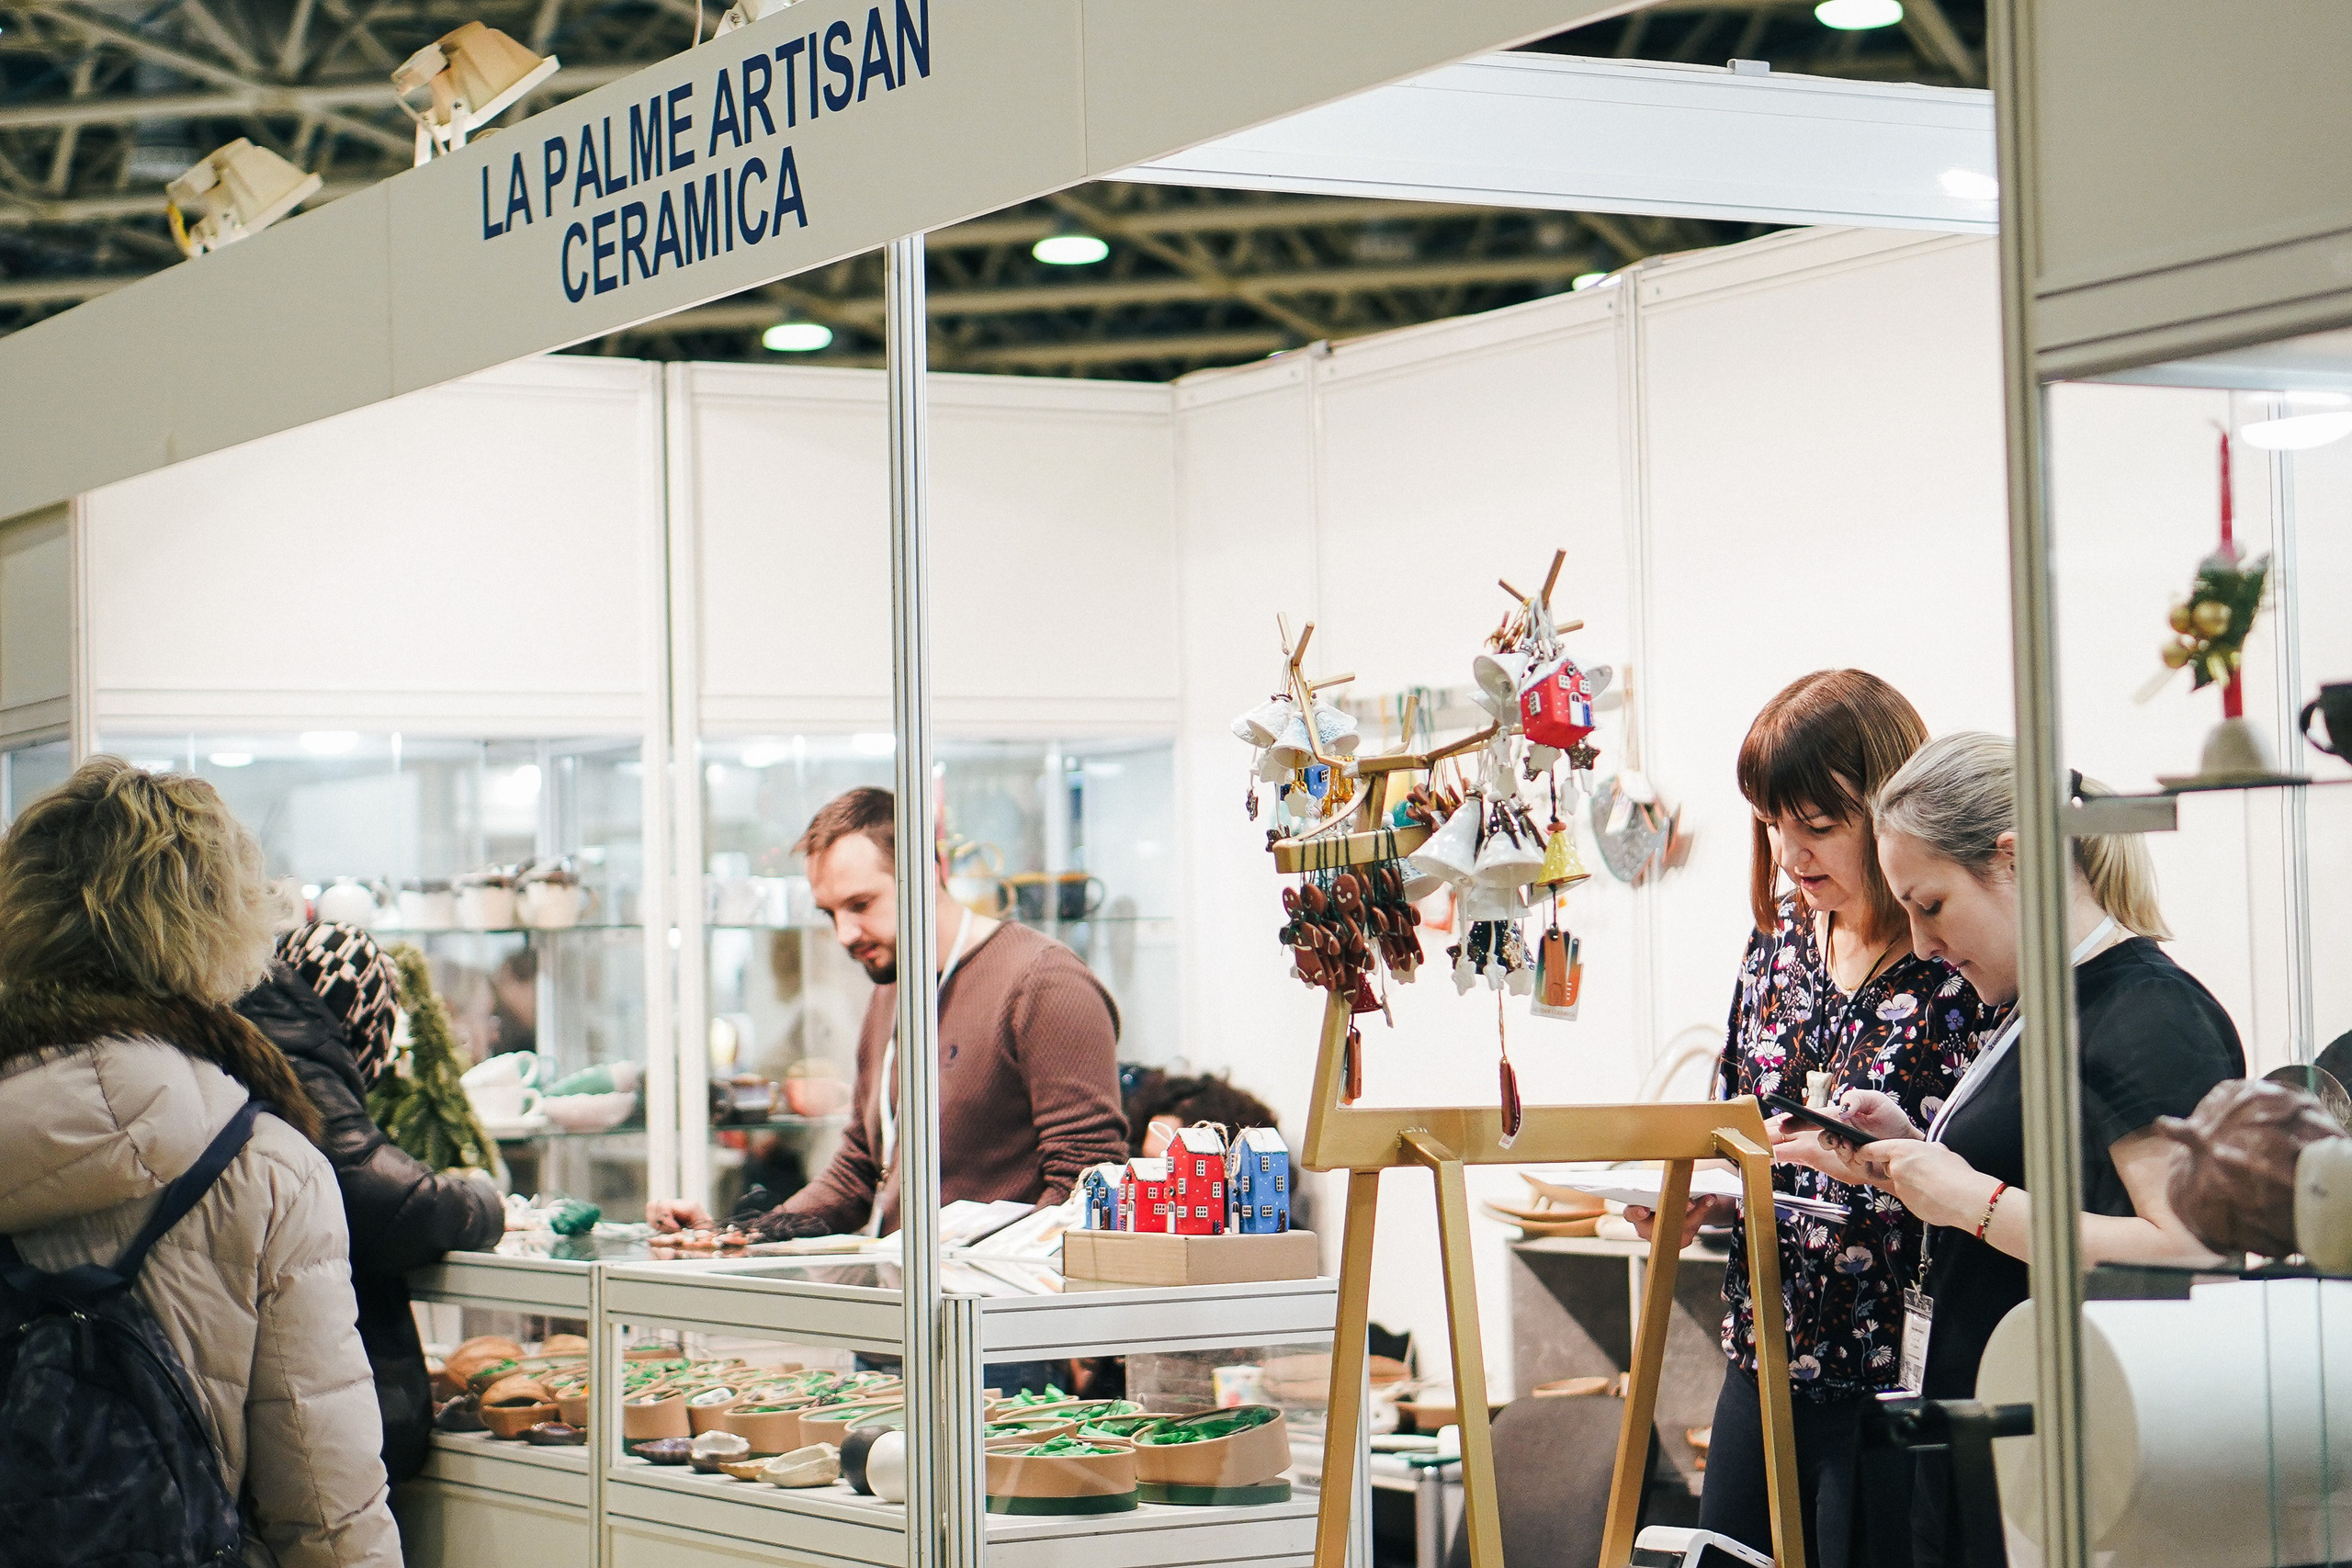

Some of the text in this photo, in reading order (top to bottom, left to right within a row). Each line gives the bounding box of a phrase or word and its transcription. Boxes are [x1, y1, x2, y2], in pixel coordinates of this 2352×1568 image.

[481, 0, 931, 241] LA PALME ARTISAN
[561, 145, 808, 304] CERAMICA
